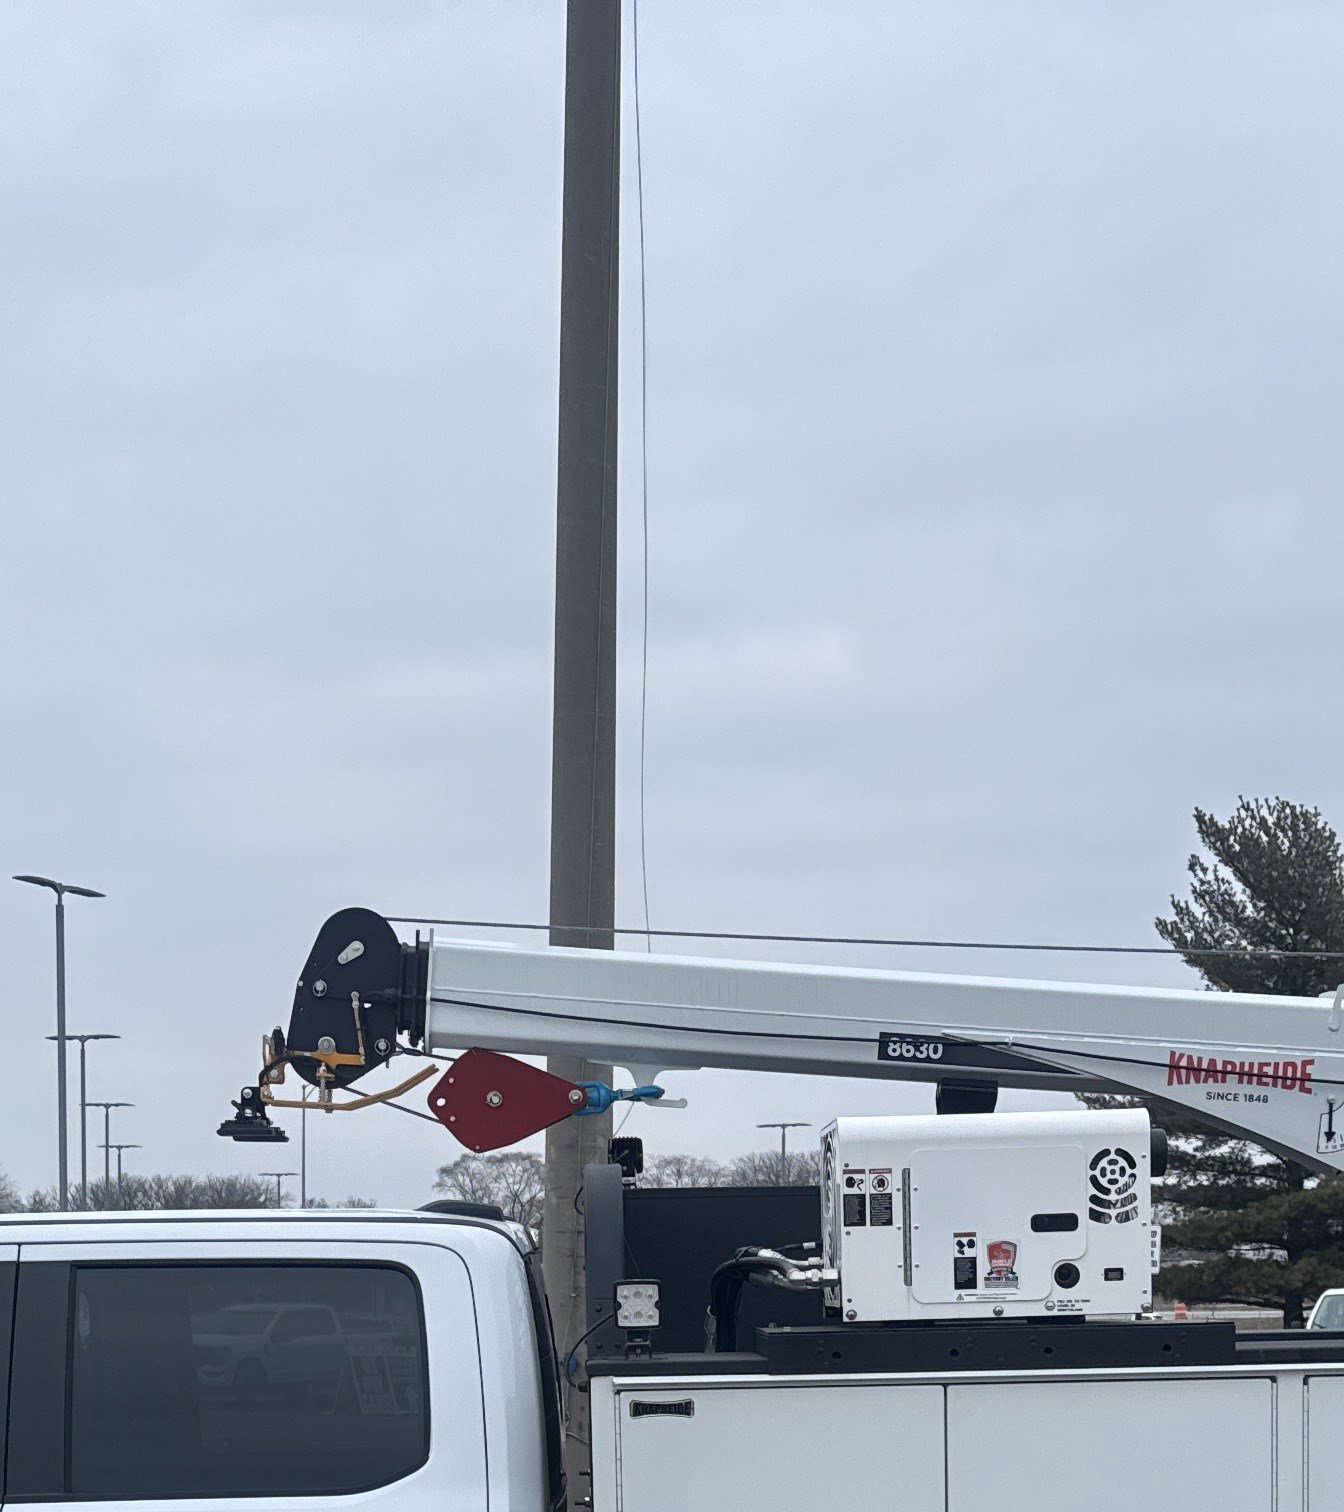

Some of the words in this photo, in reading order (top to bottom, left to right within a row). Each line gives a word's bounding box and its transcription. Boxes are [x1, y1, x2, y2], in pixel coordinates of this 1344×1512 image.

[887, 1037, 944, 1060] 8630
[1167, 1050, 1316, 1095] KNAPHEIDE
[1205, 1091, 1240, 1102] SINCE
[1244, 1093, 1269, 1104] 1848
